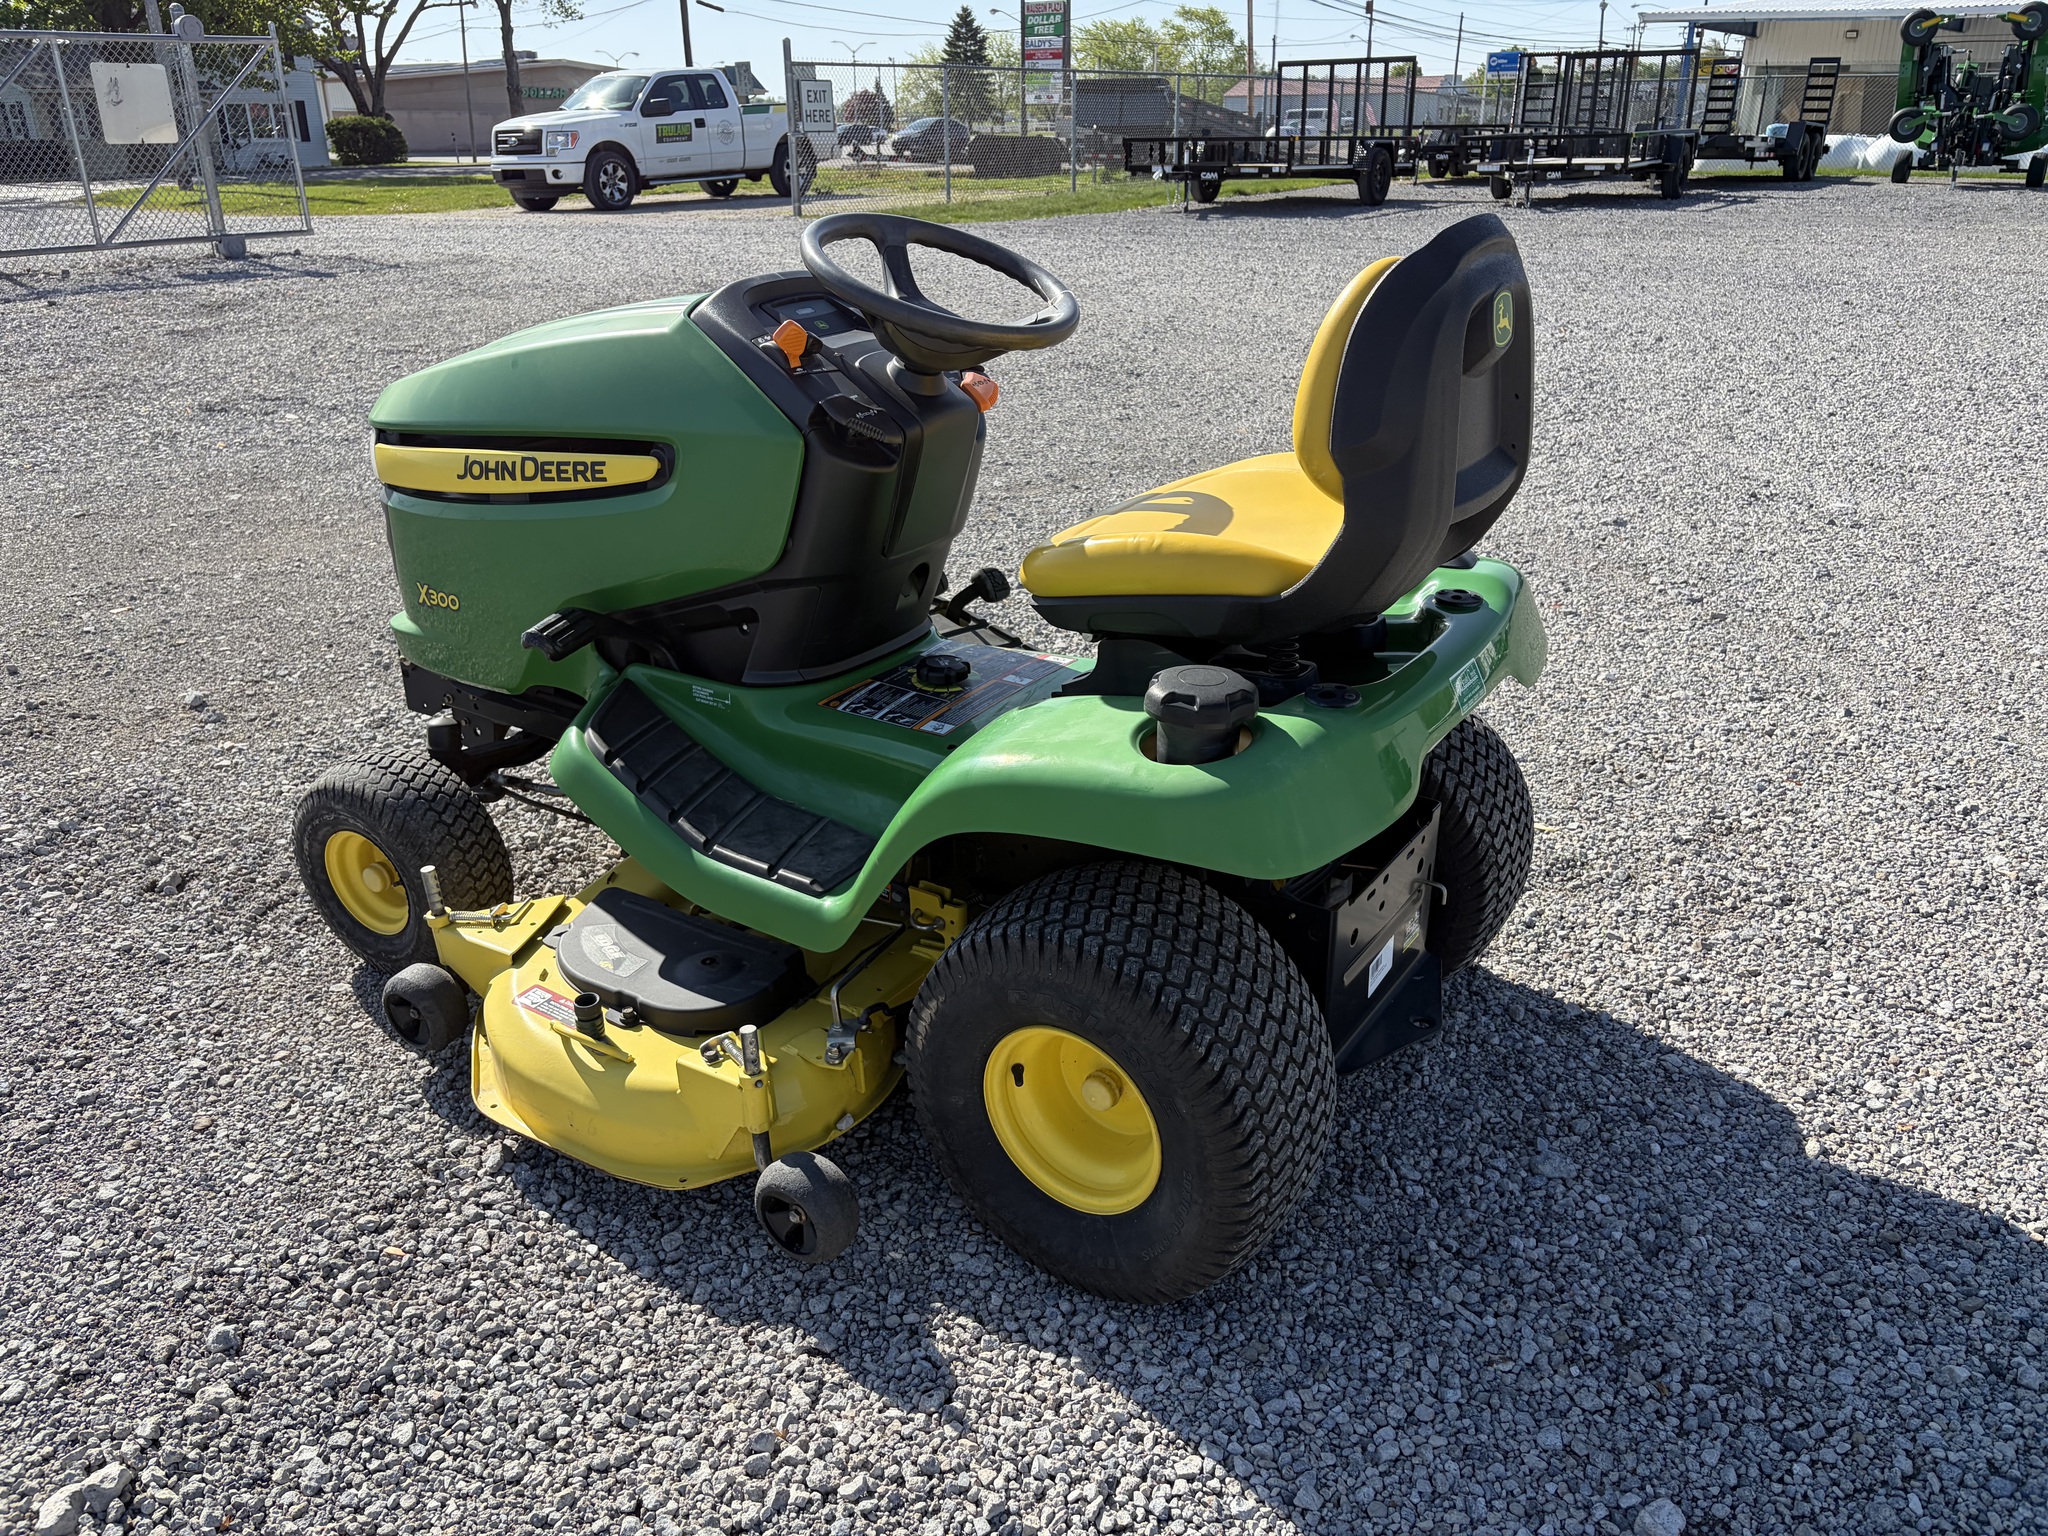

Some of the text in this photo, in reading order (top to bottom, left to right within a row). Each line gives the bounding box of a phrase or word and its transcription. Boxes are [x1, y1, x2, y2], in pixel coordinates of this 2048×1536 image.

[1027, 14, 1062, 24] DOLLAR
[1034, 25, 1055, 34] TREE
[1026, 38, 1052, 48] BALDY'S
[522, 87, 568, 99] DOLLAR
[806, 90, 827, 103] EXIT
[805, 109, 831, 123] HERE
[657, 124, 690, 137] TRULAND
[1201, 172, 1218, 180] CAM
[456, 455, 608, 482] JOHN DEERE
[416, 580, 461, 611] X300
[1007, 988, 1183, 1120] CARLISLE
